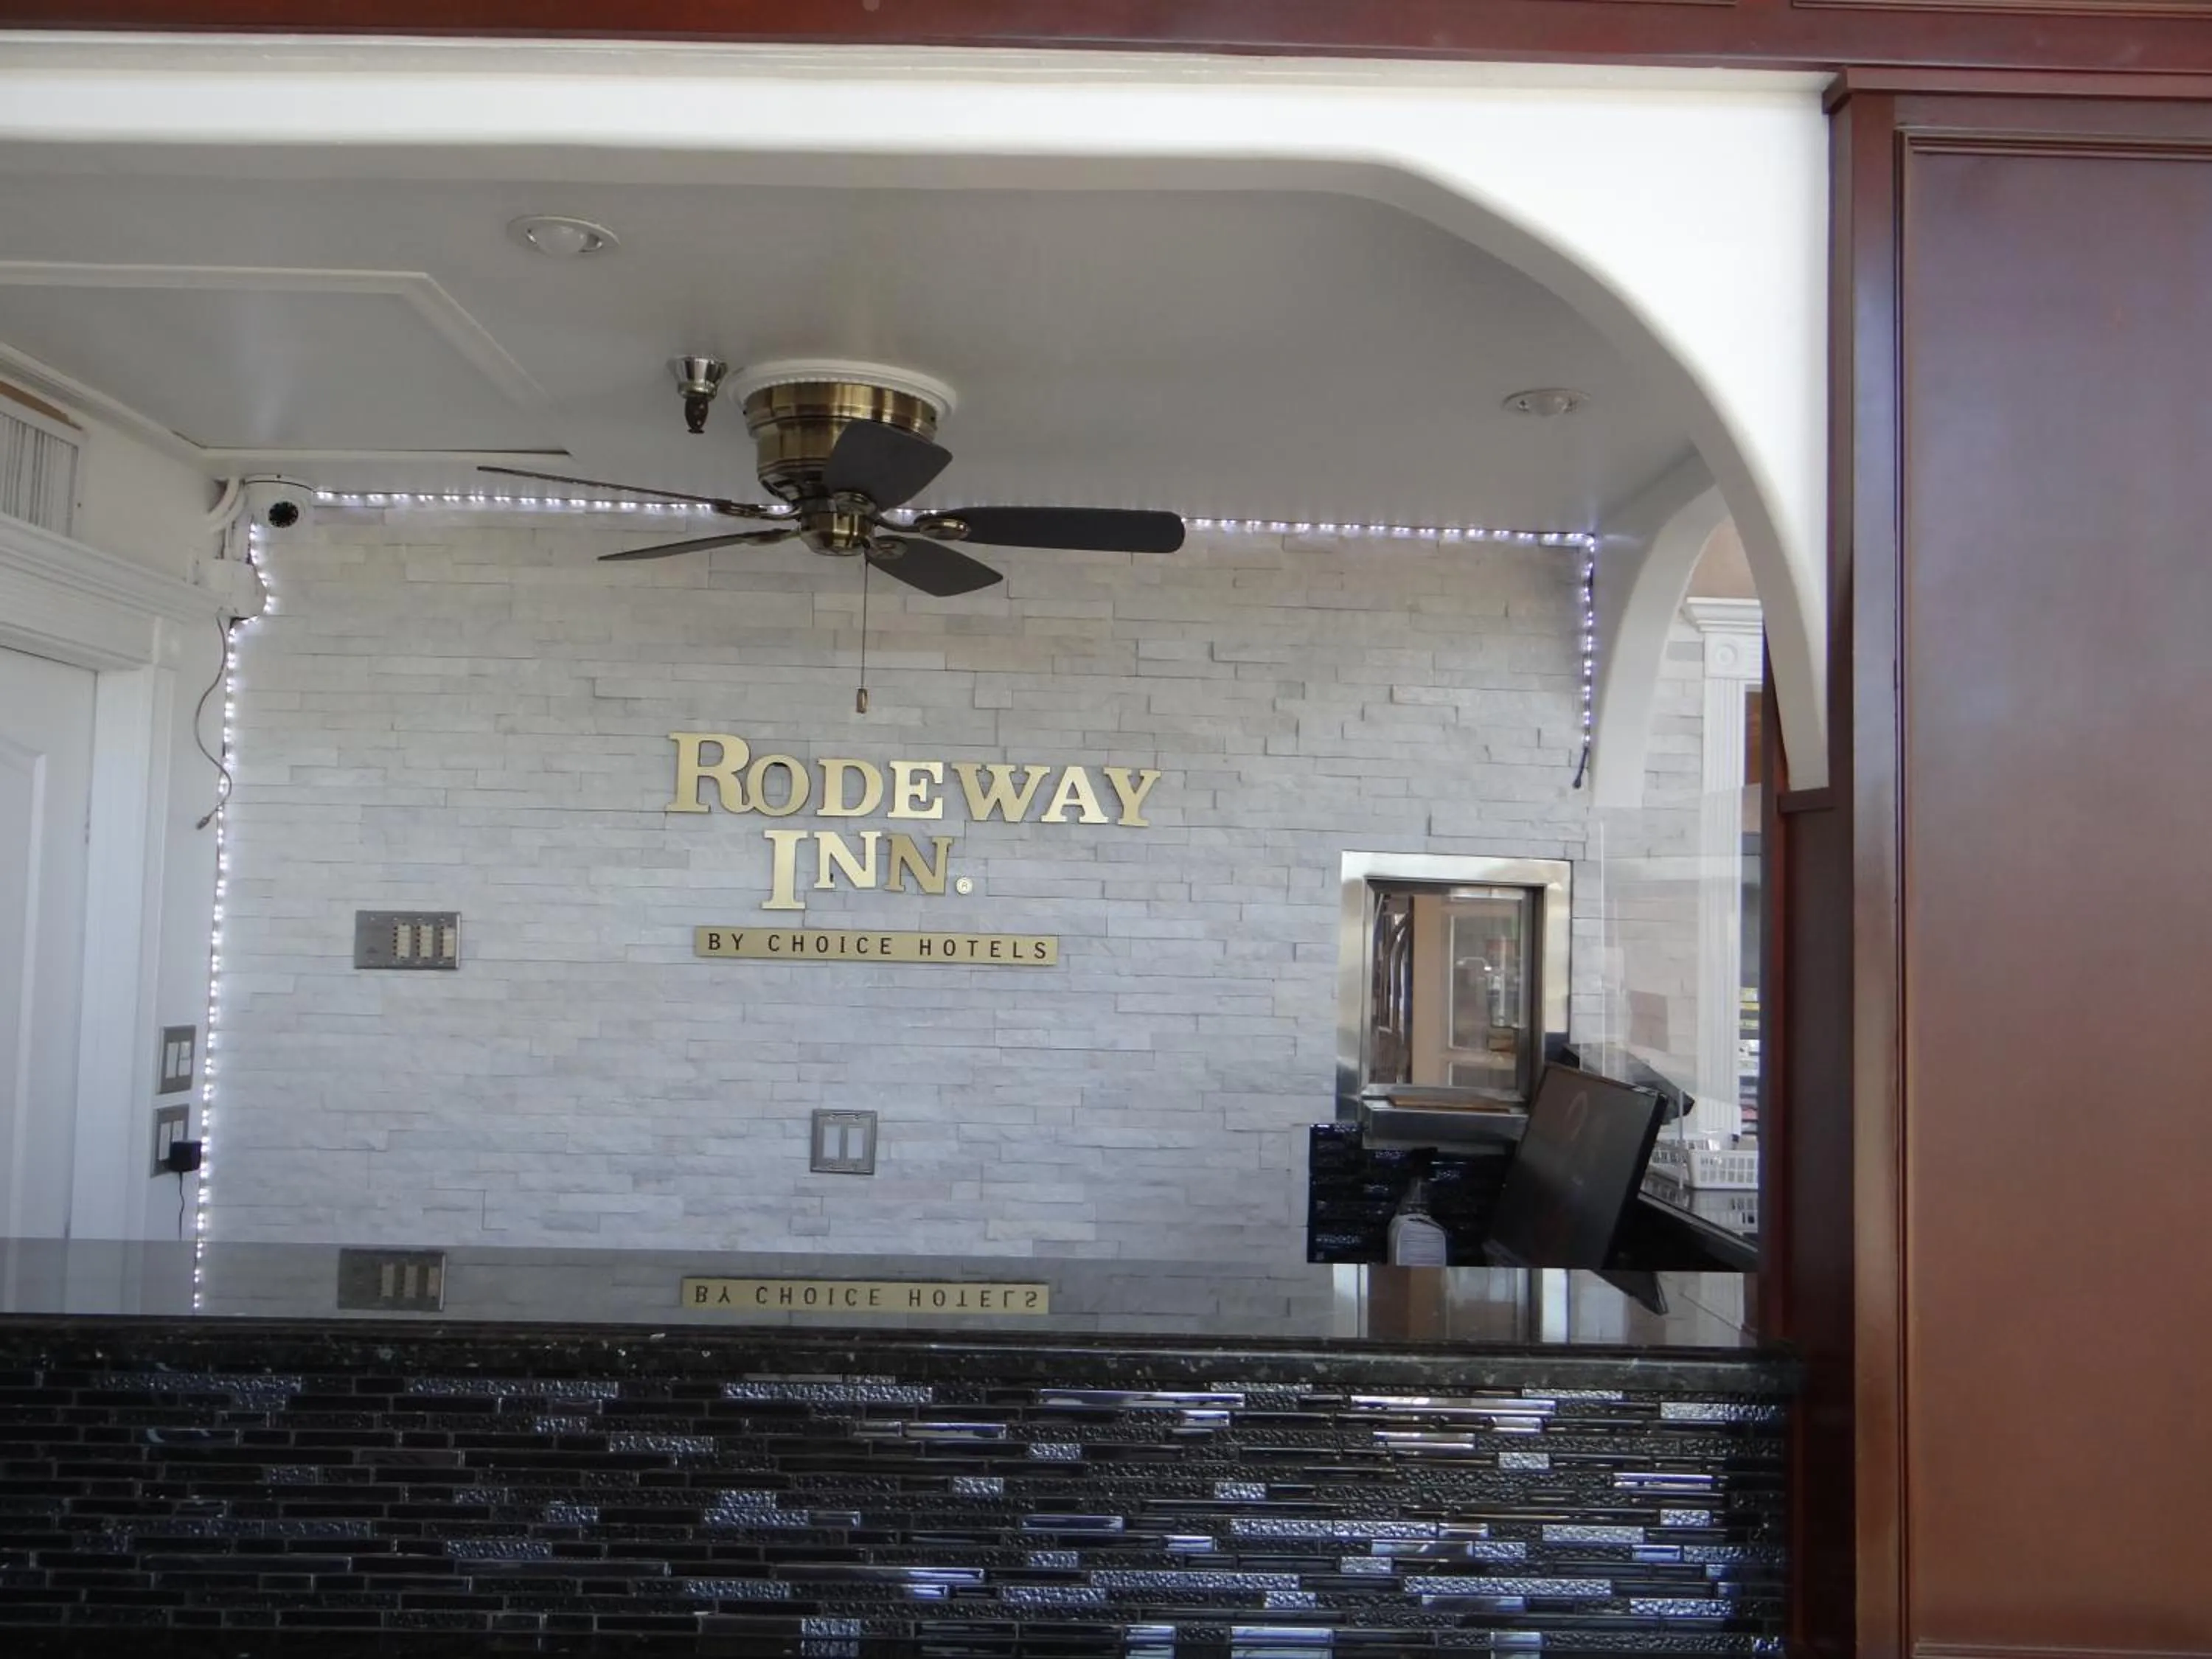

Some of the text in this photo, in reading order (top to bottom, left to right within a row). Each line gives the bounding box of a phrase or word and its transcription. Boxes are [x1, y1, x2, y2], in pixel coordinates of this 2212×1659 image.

[667, 732, 1161, 827] RODEWAY
[762, 830, 953, 910] INN
[708, 932, 1048, 961] BY CHOICE HOTELS
